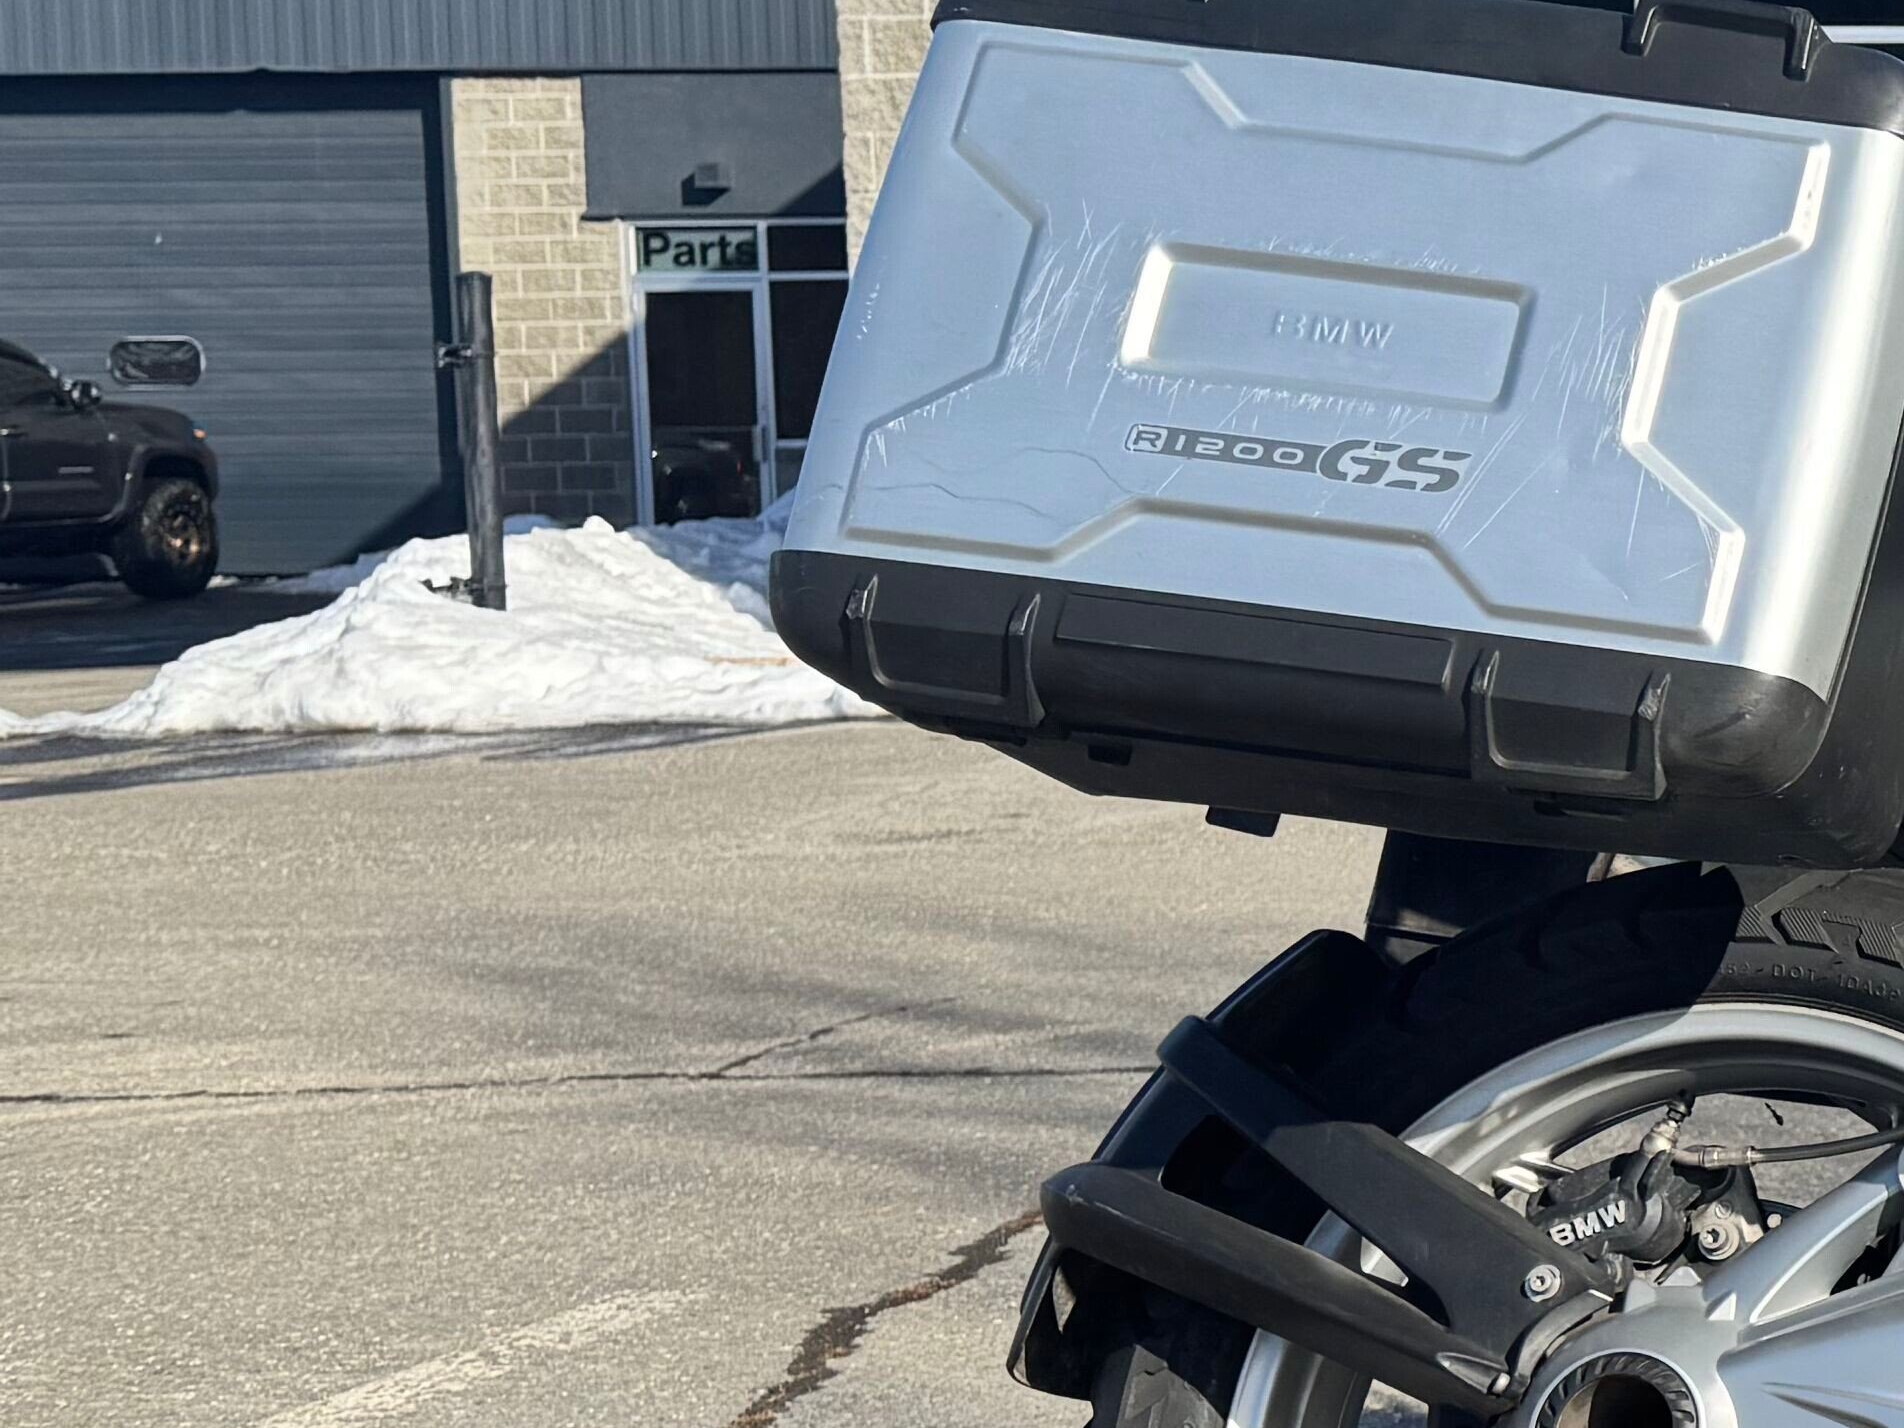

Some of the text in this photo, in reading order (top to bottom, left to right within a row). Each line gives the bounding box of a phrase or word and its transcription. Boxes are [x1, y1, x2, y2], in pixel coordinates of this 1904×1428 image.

[641, 233, 757, 269] Parts
[1274, 313, 1394, 350] BMW
[1549, 1199, 1626, 1247] BMW
